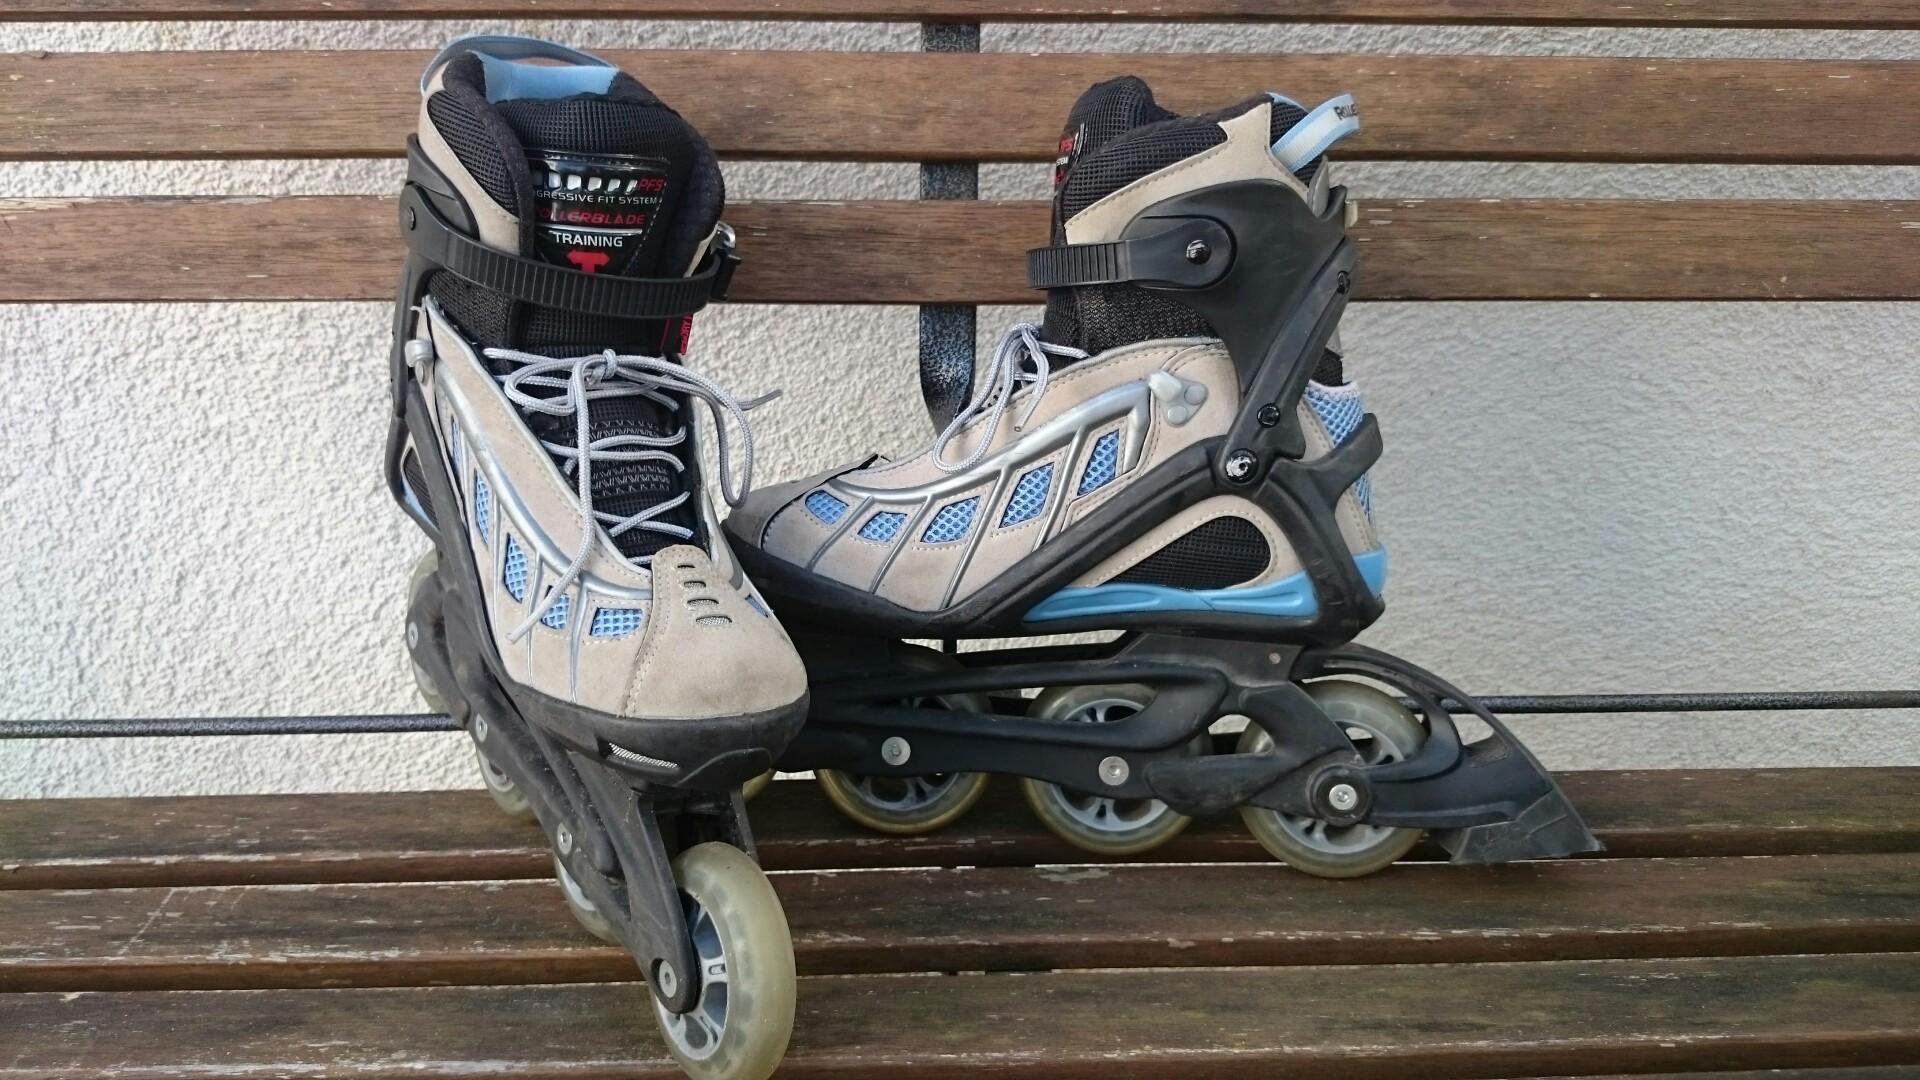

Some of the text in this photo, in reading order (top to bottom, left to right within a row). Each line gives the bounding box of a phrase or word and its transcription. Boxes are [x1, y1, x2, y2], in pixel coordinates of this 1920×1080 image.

[536, 191, 594, 203] GRESSIVE
[598, 196, 657, 206] FIT SYSTEM
[539, 208, 646, 225] OLLERBLADE
[554, 233, 623, 248] TRAINING
